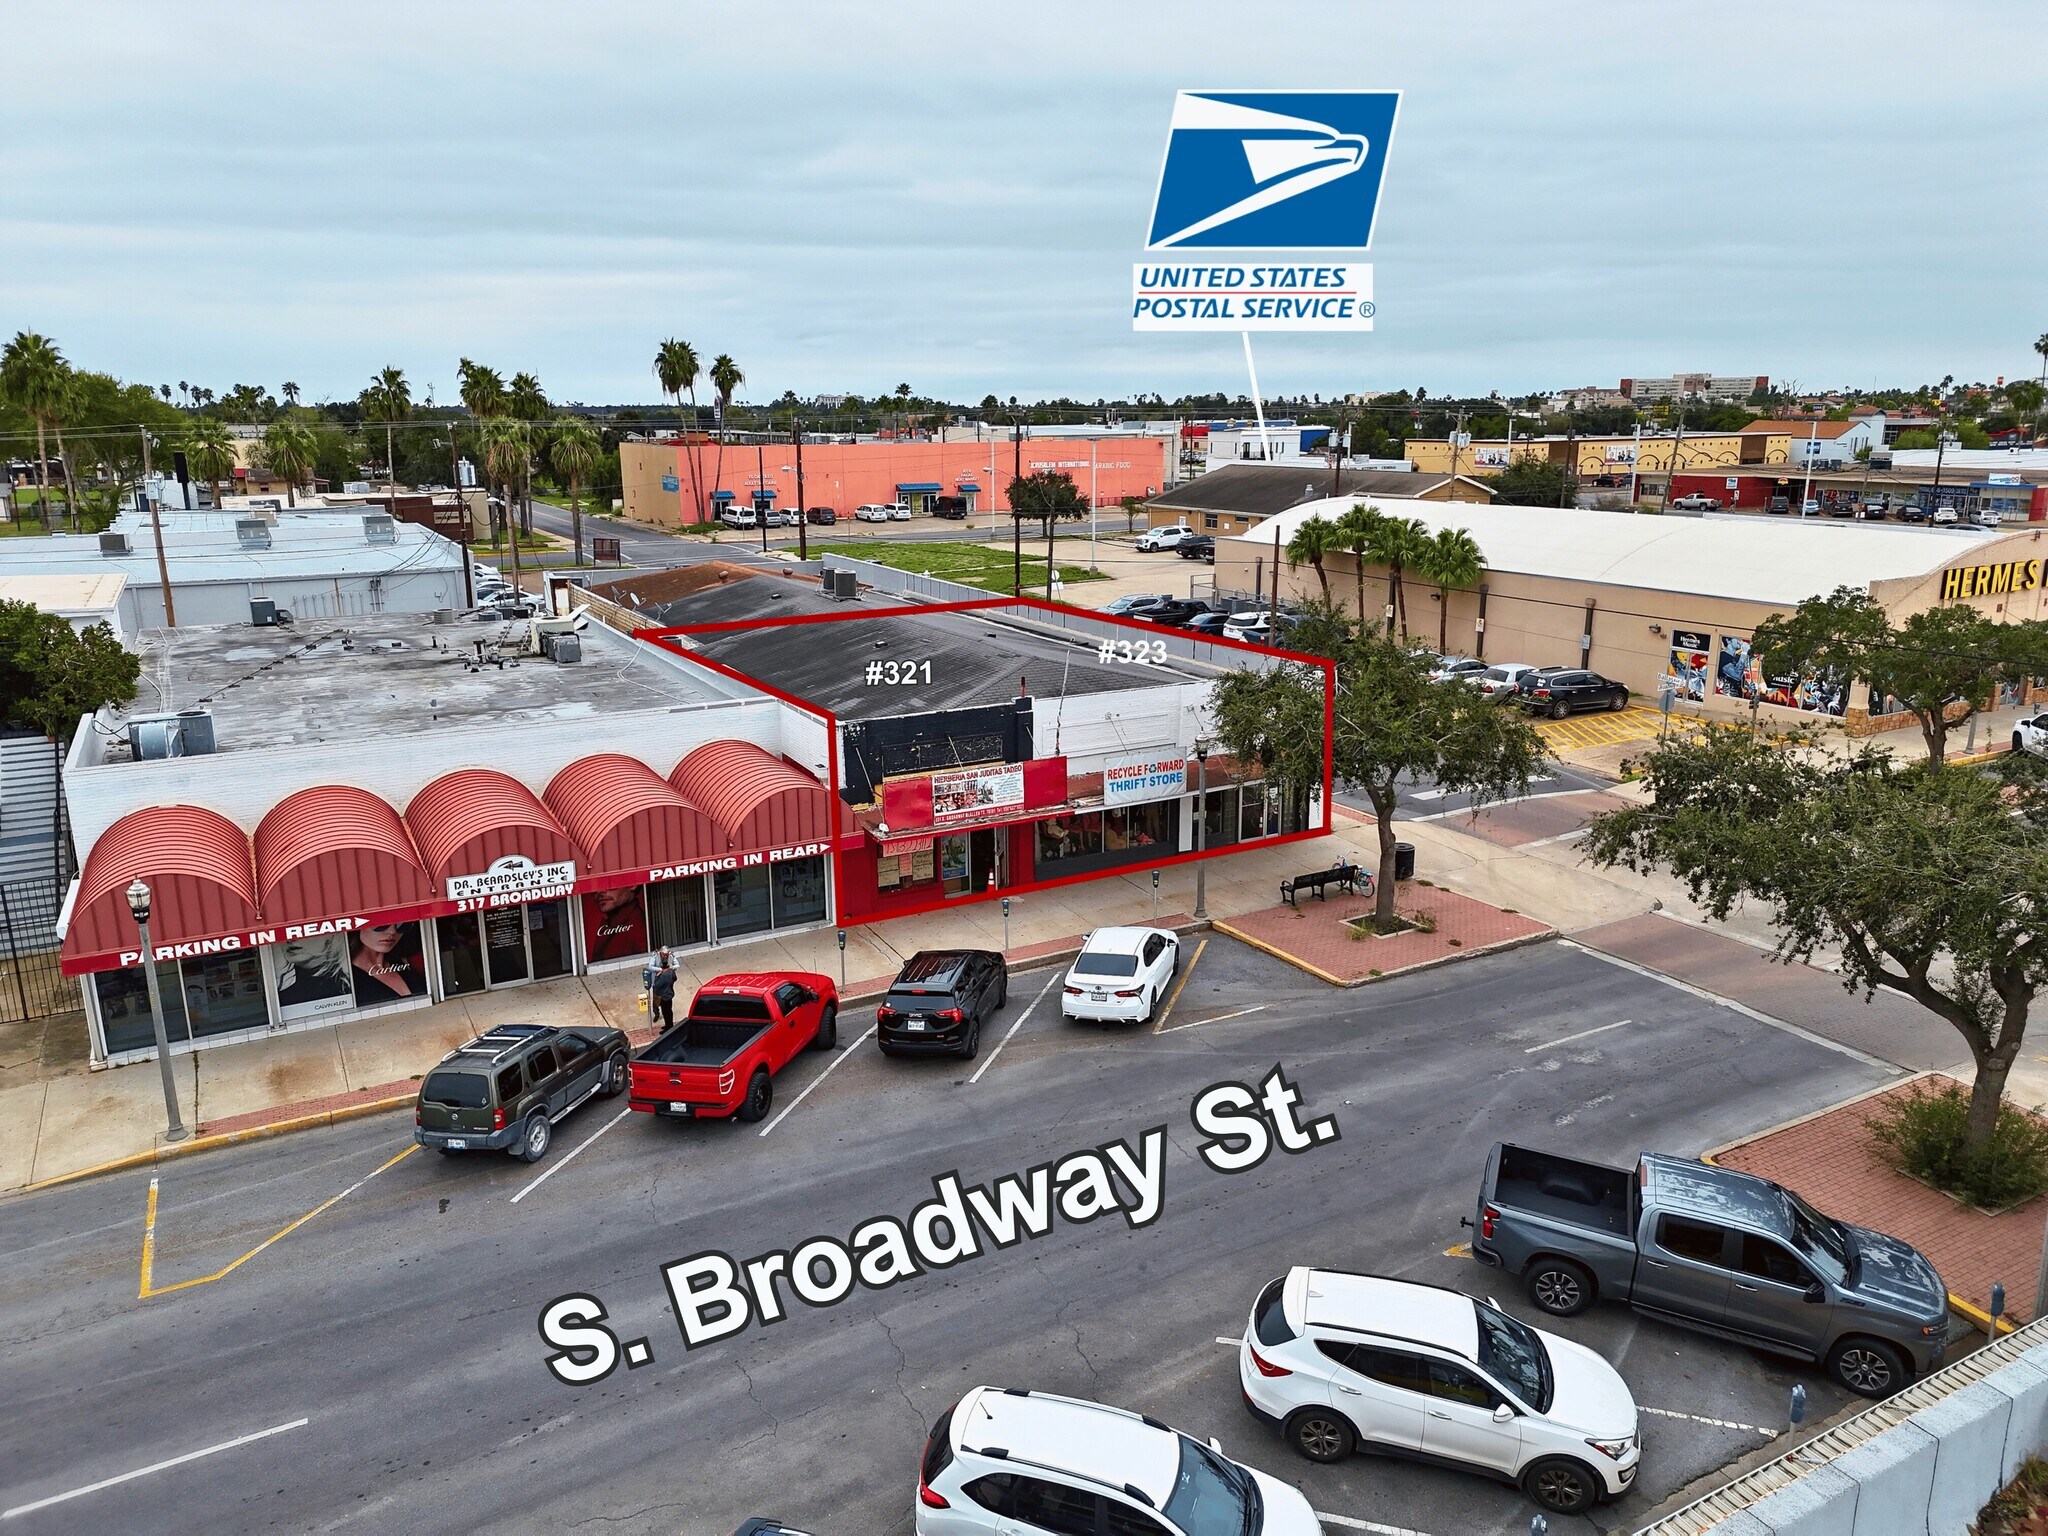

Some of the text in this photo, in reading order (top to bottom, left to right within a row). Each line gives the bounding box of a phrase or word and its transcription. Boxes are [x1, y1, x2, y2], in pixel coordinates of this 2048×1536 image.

[1940, 559, 2041, 600] HERMES
[934, 764, 1022, 784] HIERBERIA SAN JUDITAS TADEO
[1107, 765, 1143, 780] RECYCLE
[1109, 772, 1183, 793] THRIFT STORE
[650, 843, 819, 882] PARKING IN REAR
[454, 866, 569, 891] DR. BEARDSLEY'S INC.
[456, 875, 569, 897] ENTRANCE
[457, 883, 574, 913] 317 BROADWAY
[250, 932, 277, 945] IN
[286, 917, 352, 940] REAR
[597, 924, 634, 937] Cartier
[368, 962, 411, 977] Cartier
[314, 1003, 332, 1011] CALVIN
